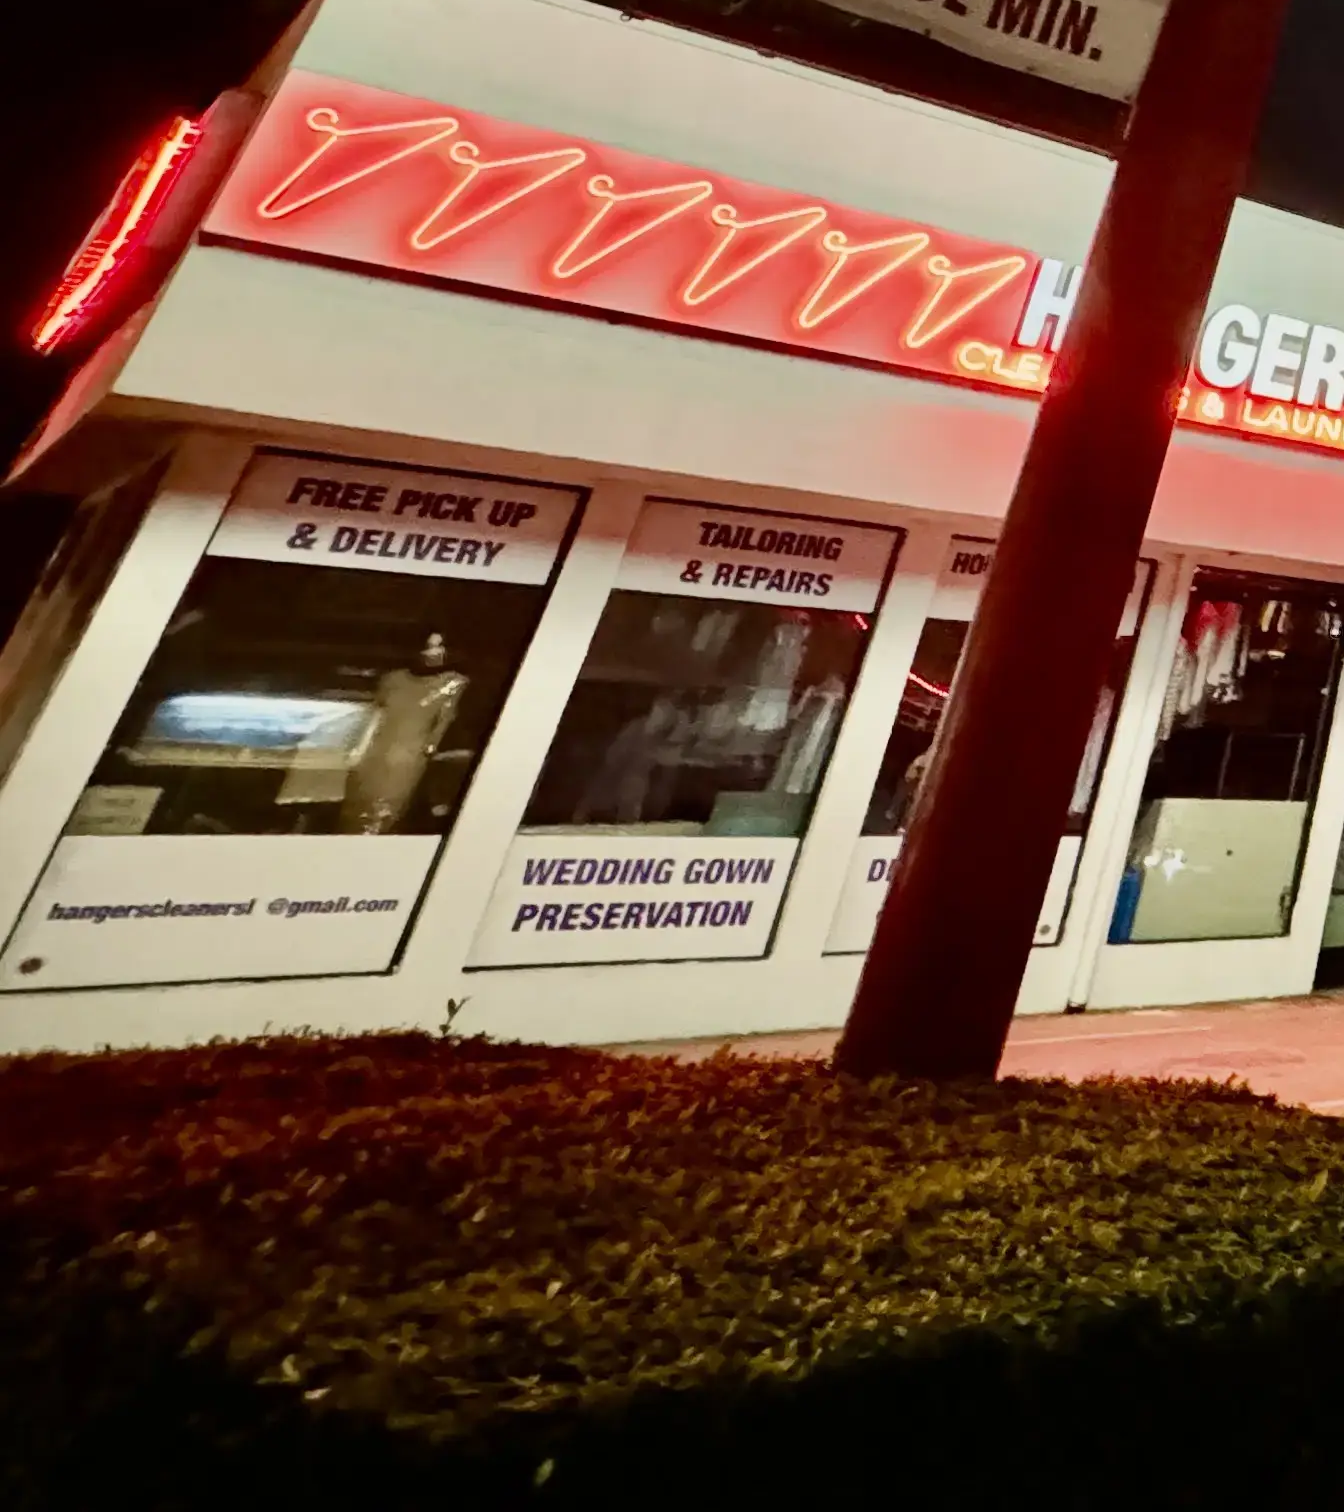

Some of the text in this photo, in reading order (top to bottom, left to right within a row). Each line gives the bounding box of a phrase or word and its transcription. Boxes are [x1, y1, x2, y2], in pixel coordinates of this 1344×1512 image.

[286, 476, 538, 527] FREE PICK UP
[286, 522, 506, 567] & DELIVERY
[698, 521, 844, 562] TAILORING
[679, 560, 834, 597] & REPAIRS
[522, 857, 775, 886] WEDDING GOWN
[511, 899, 754, 932] PRESERVATION
